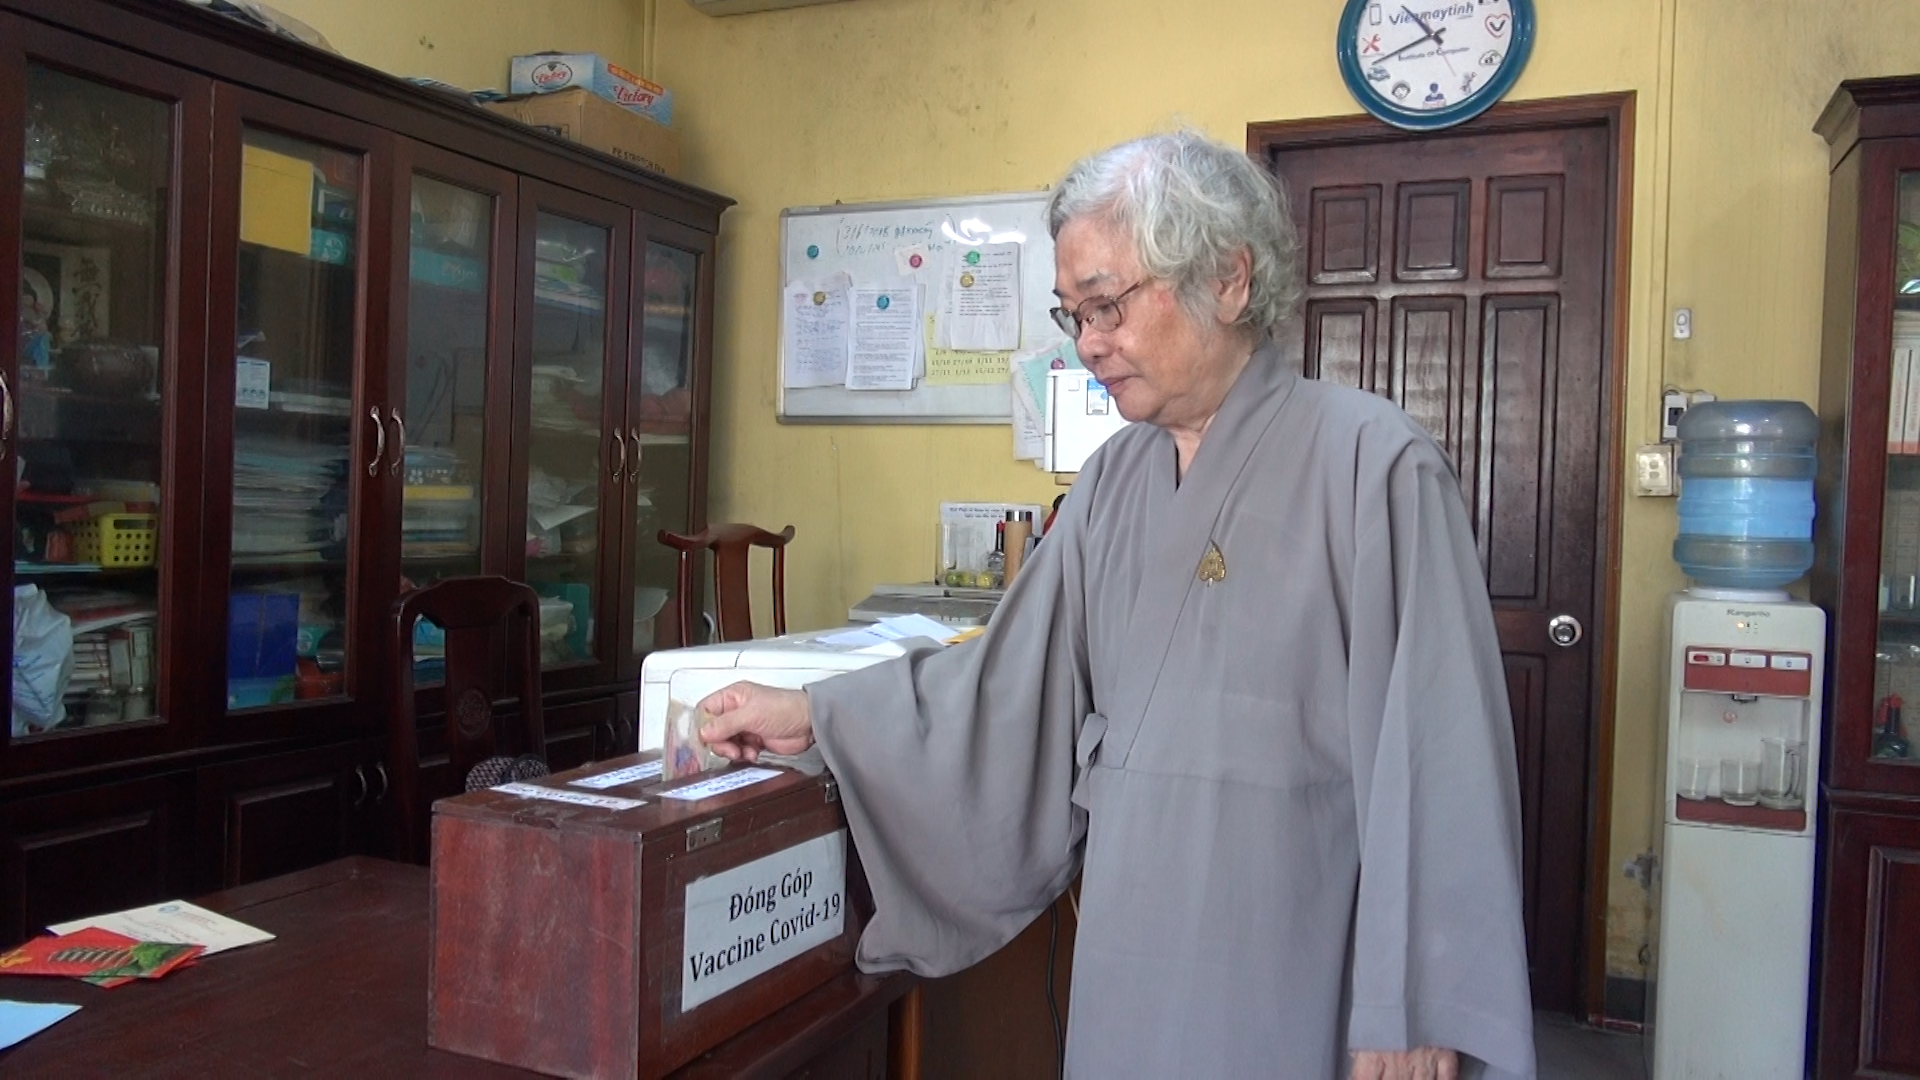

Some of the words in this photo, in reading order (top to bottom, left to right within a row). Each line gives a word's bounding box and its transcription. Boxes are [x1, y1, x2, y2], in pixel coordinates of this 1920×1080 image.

[729, 885, 777, 922] Đóng
[781, 867, 813, 898] Góp
[690, 935, 765, 982] Vaccine
[770, 893, 841, 946] Covid-19
